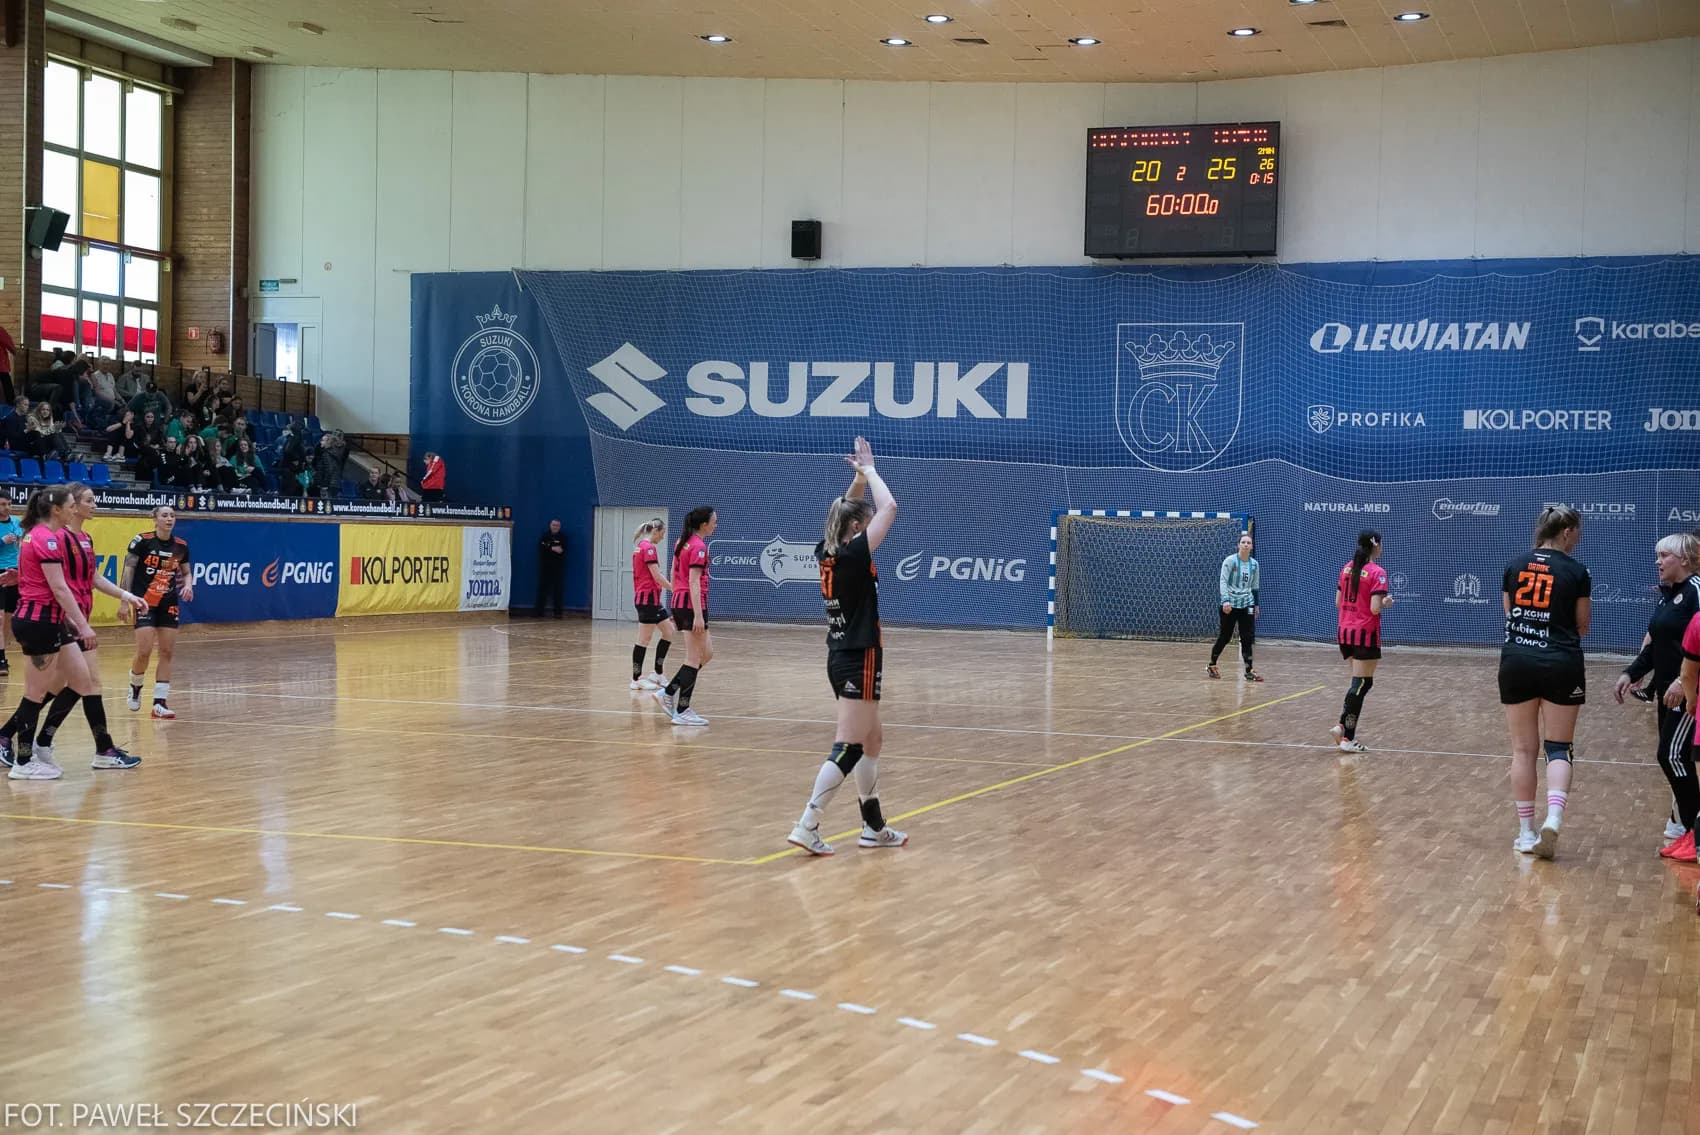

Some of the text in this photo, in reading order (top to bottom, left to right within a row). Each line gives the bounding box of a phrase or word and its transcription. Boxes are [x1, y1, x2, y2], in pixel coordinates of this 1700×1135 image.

[1131, 160, 1162, 182] 20
[1176, 166, 1187, 181] 2
[1207, 158, 1237, 180] 25
[1259, 158, 1275, 170] 26
[480, 335, 513, 348] SUZUKI
[1354, 318, 1531, 351] LEWIATAN
[460, 384, 531, 417] KORONA HANDBALL
[686, 360, 1029, 419] SUZUKI
[1337, 412, 1426, 427] PROFIKA
[1477, 409, 1612, 430] KOLPORTER
[1304, 502, 1390, 513] NATURAL-MED
[361, 556, 450, 585] KOLPORTER
[724, 556, 758, 566] PGNiG
[929, 556, 1027, 582] PGNiG
[192, 562, 251, 585] PGNiG
[281, 561, 334, 584] PGNiG
[1514, 570, 1554, 609] 20
